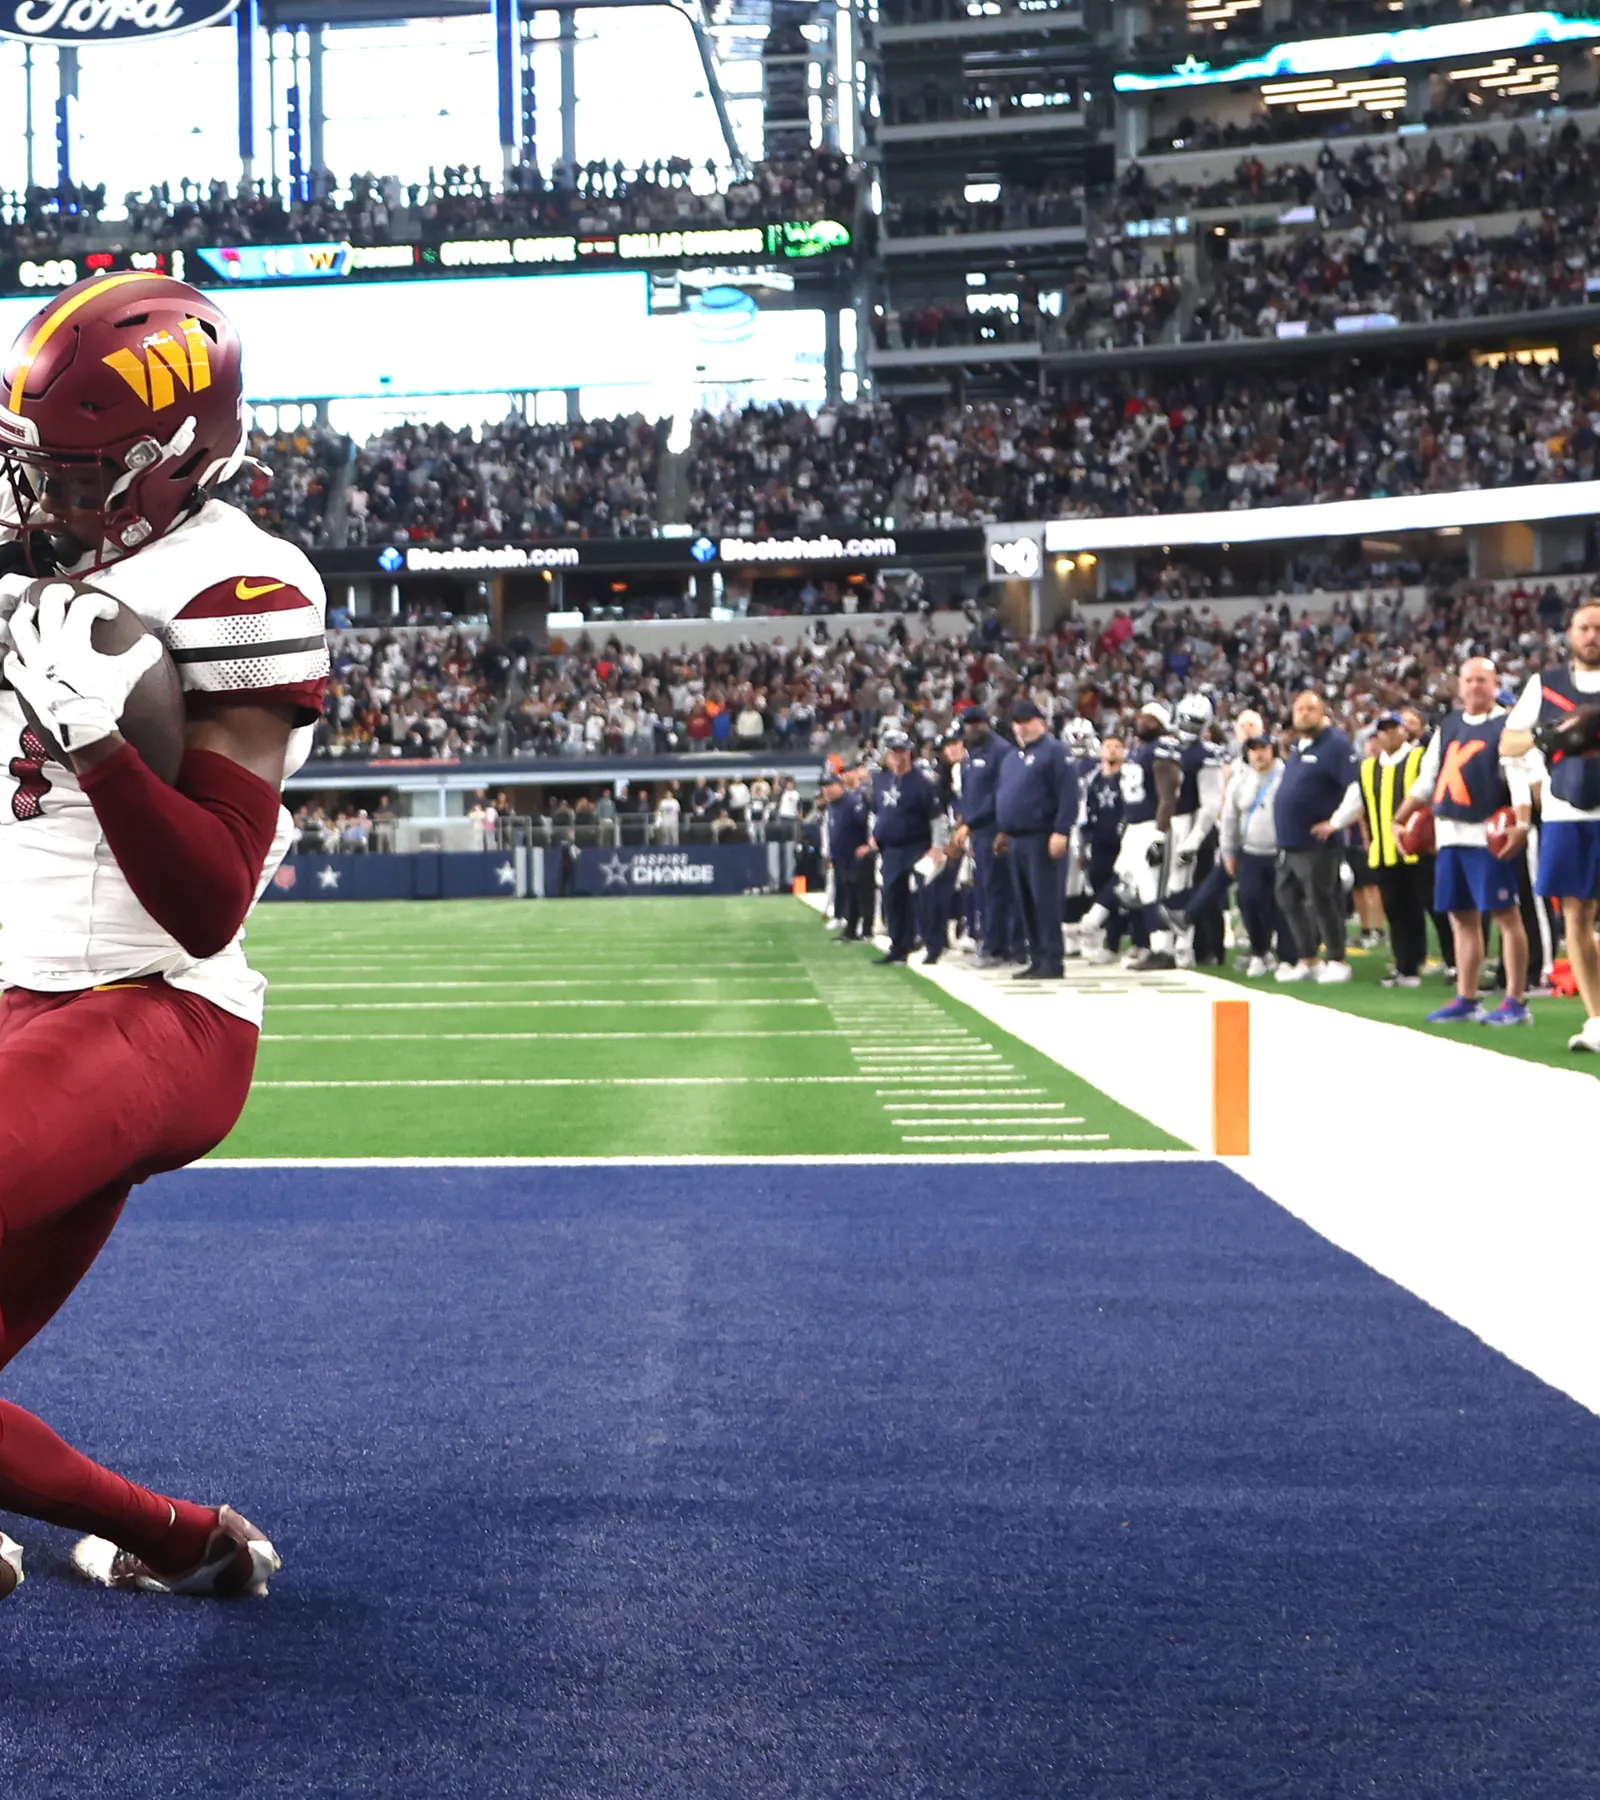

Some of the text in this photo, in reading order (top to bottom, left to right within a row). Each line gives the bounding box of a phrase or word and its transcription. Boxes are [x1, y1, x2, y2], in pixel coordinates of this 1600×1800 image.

[101, 316, 212, 412] W
[407, 545, 579, 571] Blockchain.com
[720, 534, 896, 561] Blockchain.com
[1432, 739, 1487, 808] K
[632, 864, 714, 884] CHANGE
